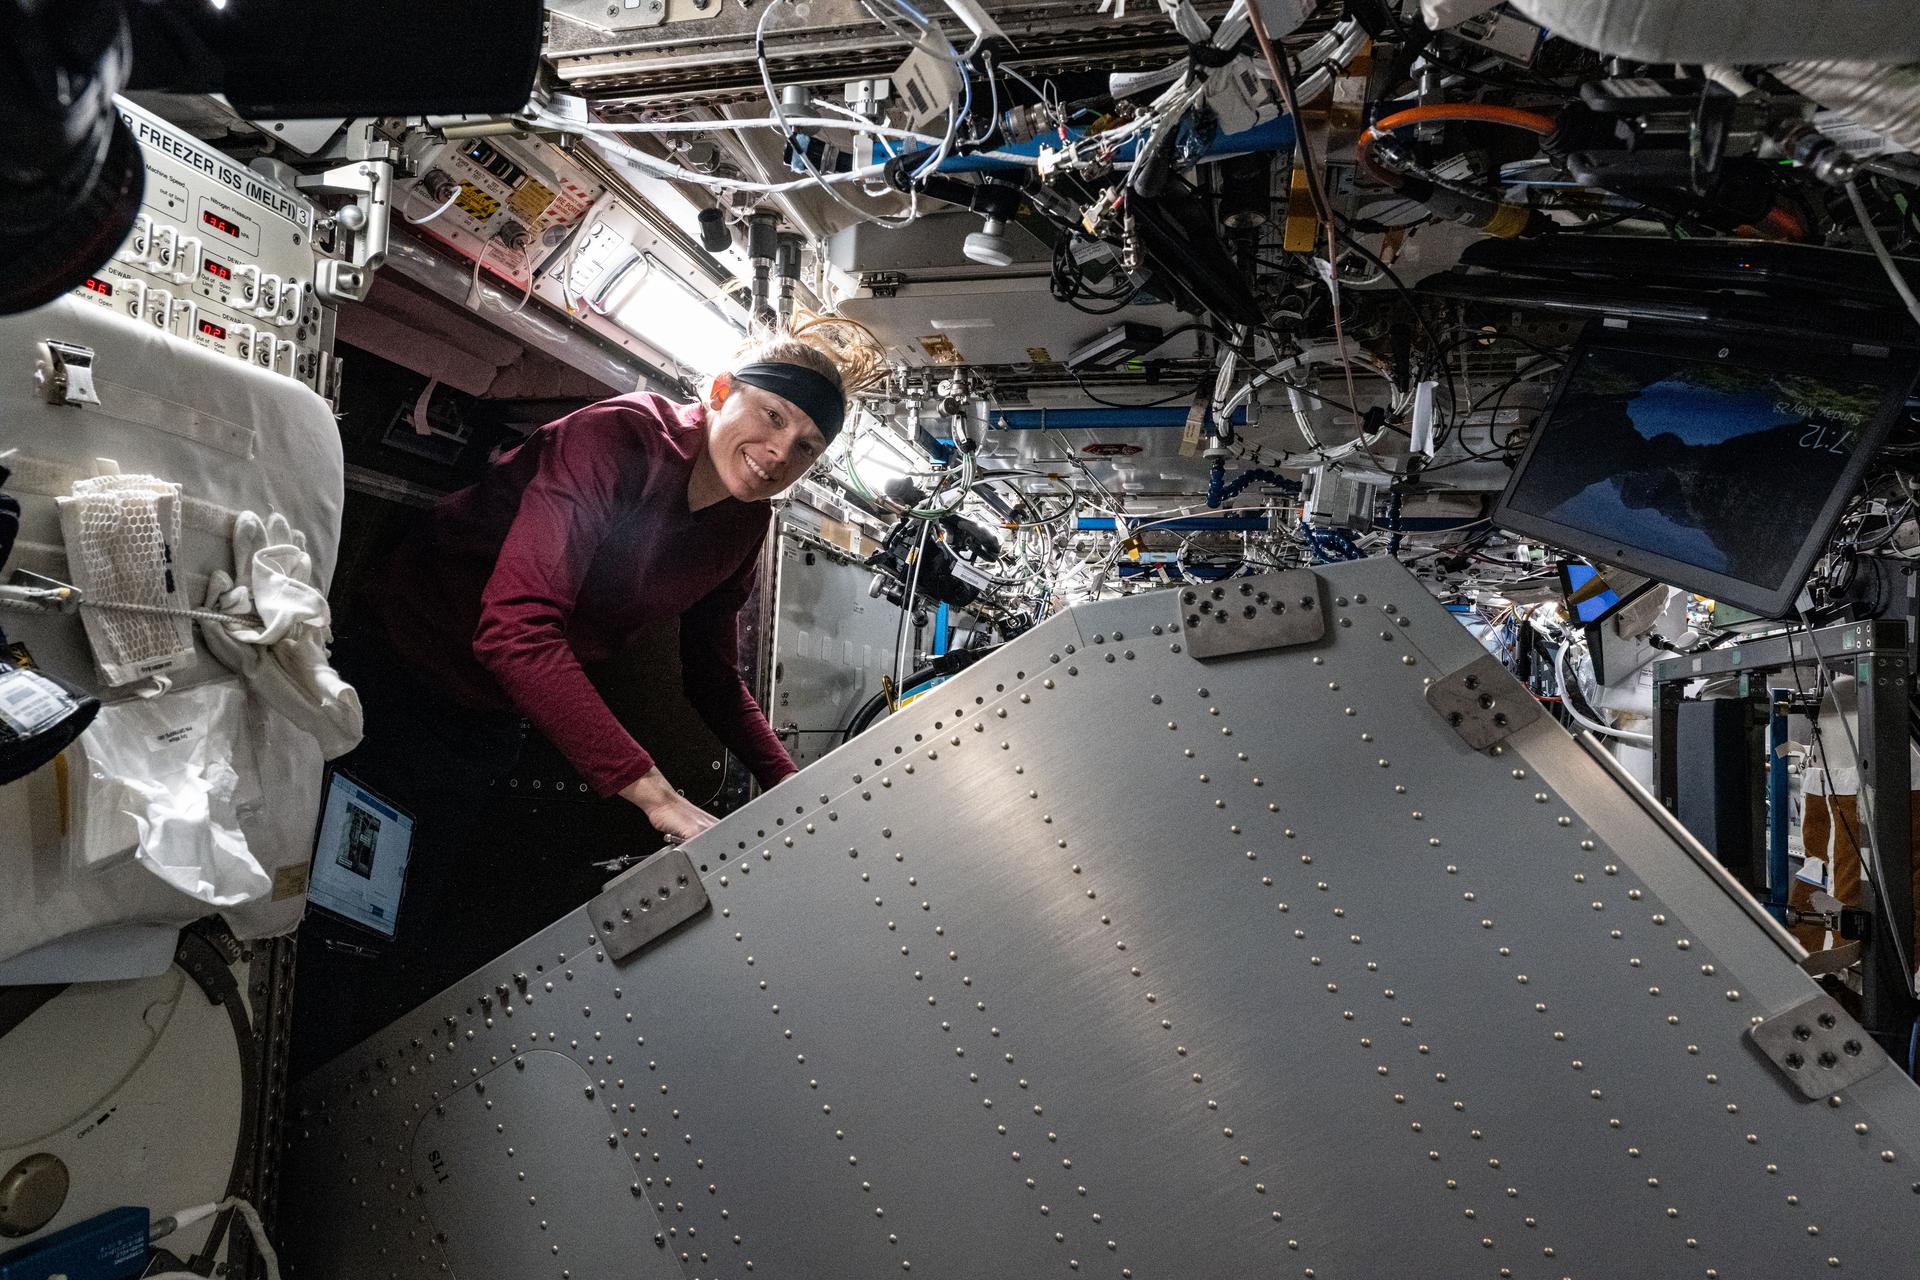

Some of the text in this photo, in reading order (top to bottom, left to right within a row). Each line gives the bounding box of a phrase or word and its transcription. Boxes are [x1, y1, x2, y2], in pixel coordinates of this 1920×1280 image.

[139, 122, 214, 175] FREEZER
[219, 166, 241, 189] ISS
[245, 181, 296, 220] (MELFI)
[145, 163, 186, 189] Machine Speed
[210, 196, 252, 222] Nitrogen Pressure
[299, 209, 307, 225] 3
[565, 202, 580, 215] PORT
[108, 266, 131, 280] DEWAR
[1791, 401, 1816, 418] May
[1819, 406, 1863, 426] Sunday,
[1799, 424, 1853, 454] 7:12
